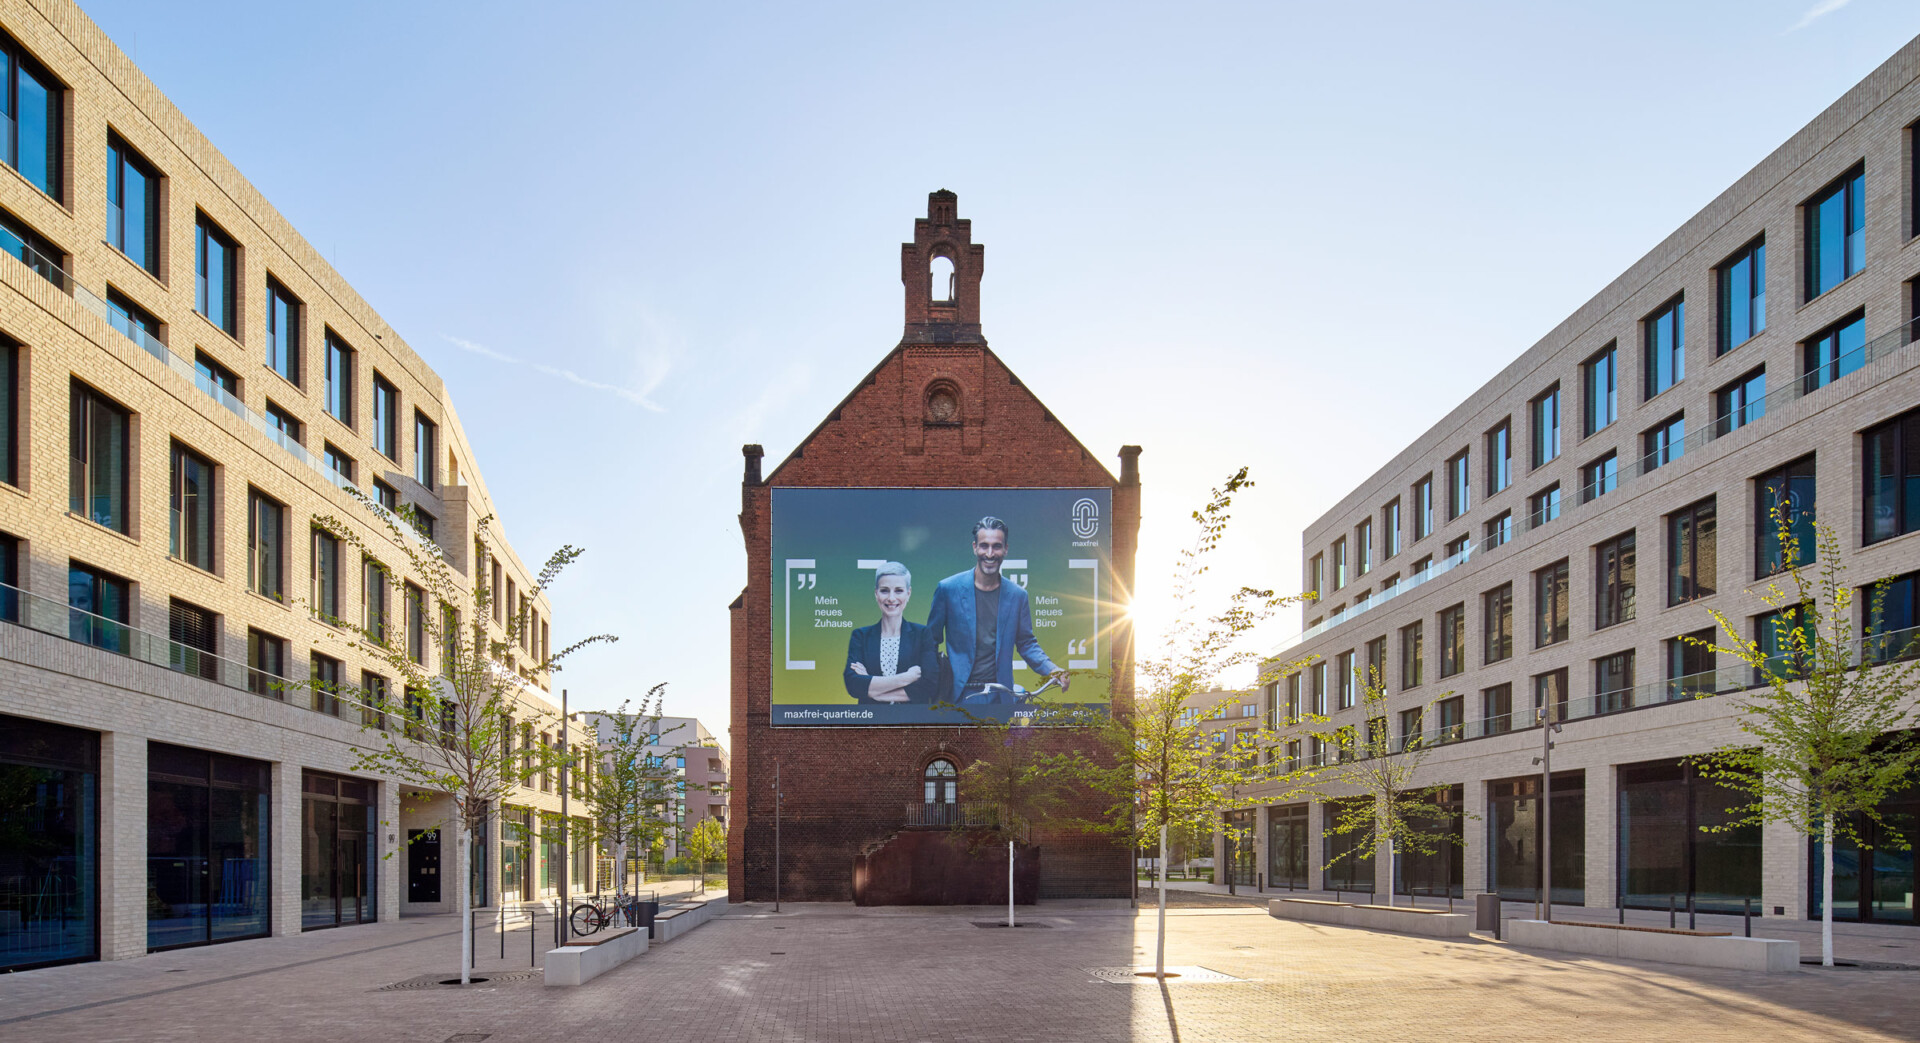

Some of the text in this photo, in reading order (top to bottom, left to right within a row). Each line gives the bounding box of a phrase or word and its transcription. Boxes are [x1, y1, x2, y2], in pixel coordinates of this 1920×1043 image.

[815, 596, 838, 605] Mein
[1035, 596, 1059, 605] Mein
[814, 619, 853, 628] Zuhause
[1035, 618, 1057, 628] Büro
[784, 710, 874, 720] maxfrei-quartier.de
[427, 832, 436, 840] 99
